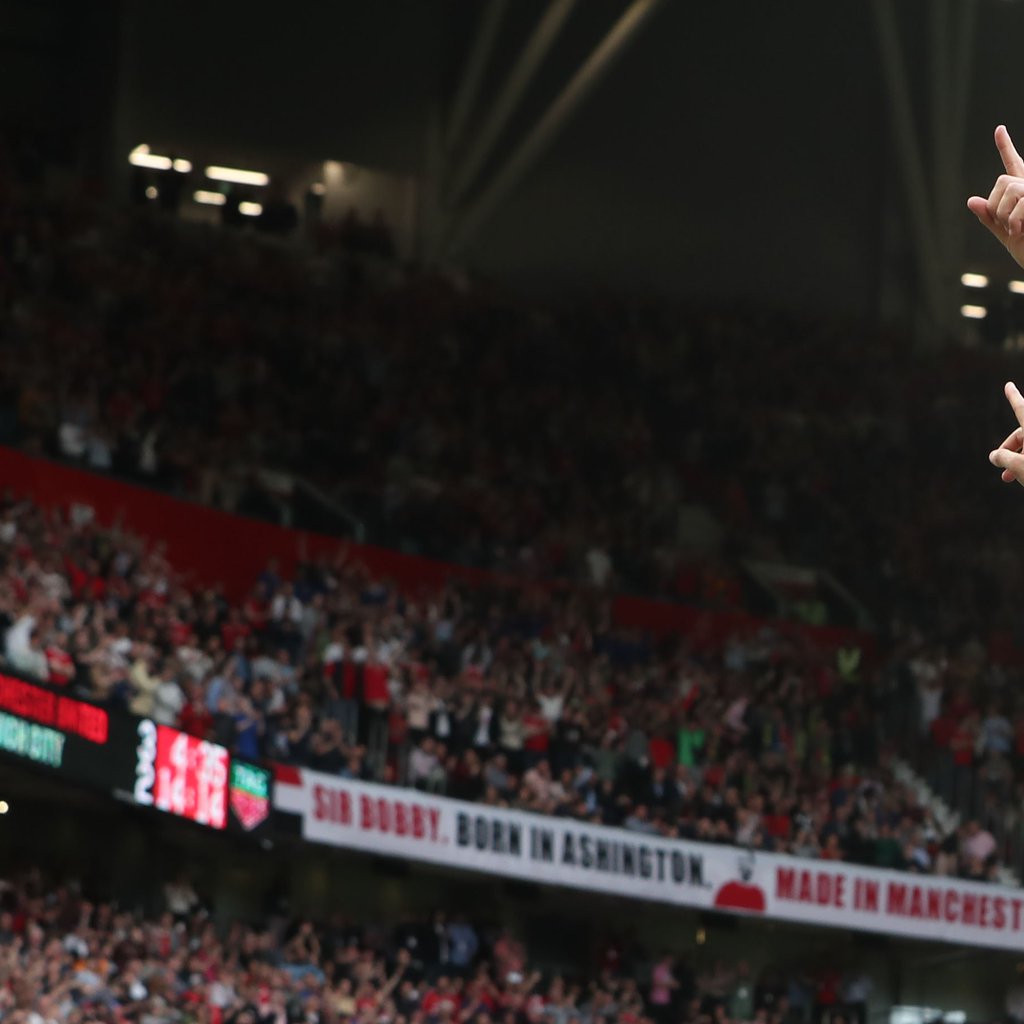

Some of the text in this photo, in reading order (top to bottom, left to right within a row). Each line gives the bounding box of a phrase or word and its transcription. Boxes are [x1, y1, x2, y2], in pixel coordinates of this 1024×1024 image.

[312, 783, 352, 827] SIR
[359, 794, 449, 844] BOBBY.
[456, 810, 521, 857] BORN
[530, 825, 555, 863] IN
[561, 832, 713, 889] ASHINGTON.
[775, 866, 845, 909] MADE
[854, 875, 878, 911] IN
